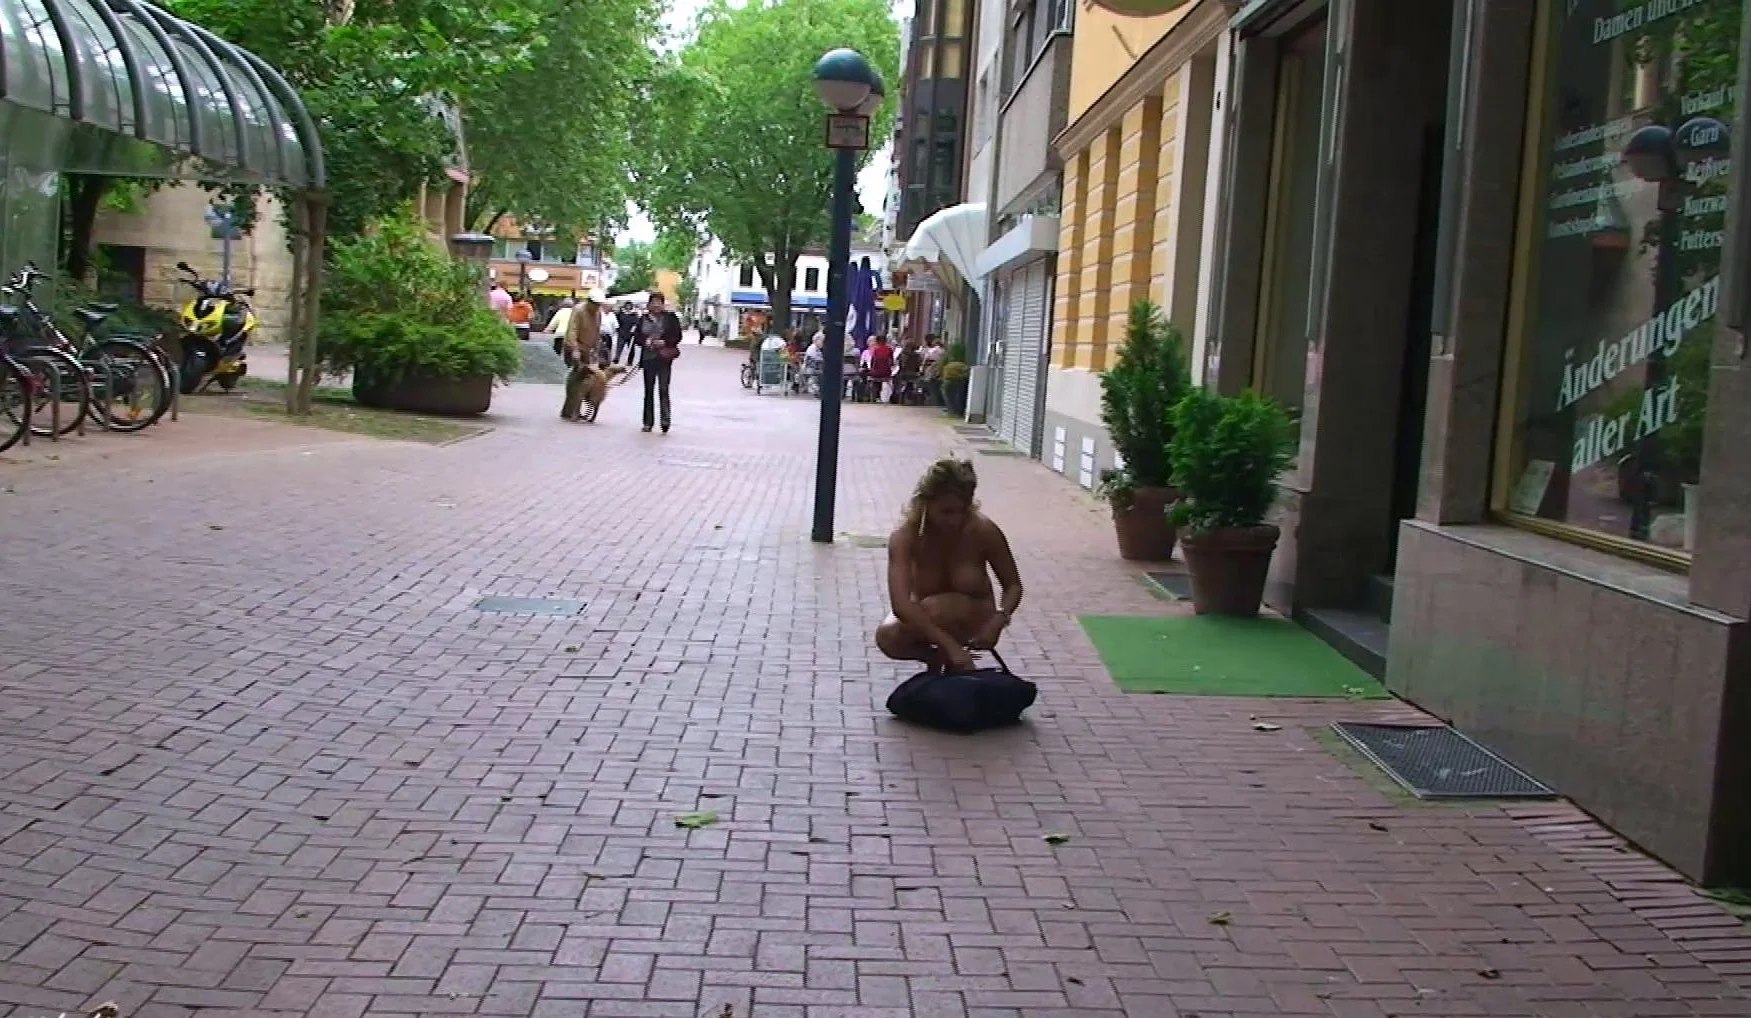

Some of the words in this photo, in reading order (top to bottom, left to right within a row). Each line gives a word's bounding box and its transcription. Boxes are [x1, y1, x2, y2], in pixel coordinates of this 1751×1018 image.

[1593, 5, 1643, 44] Damen
[1556, 274, 1719, 412] Änderungen
[1570, 410, 1632, 475] aller
[1632, 374, 1681, 441] Art
